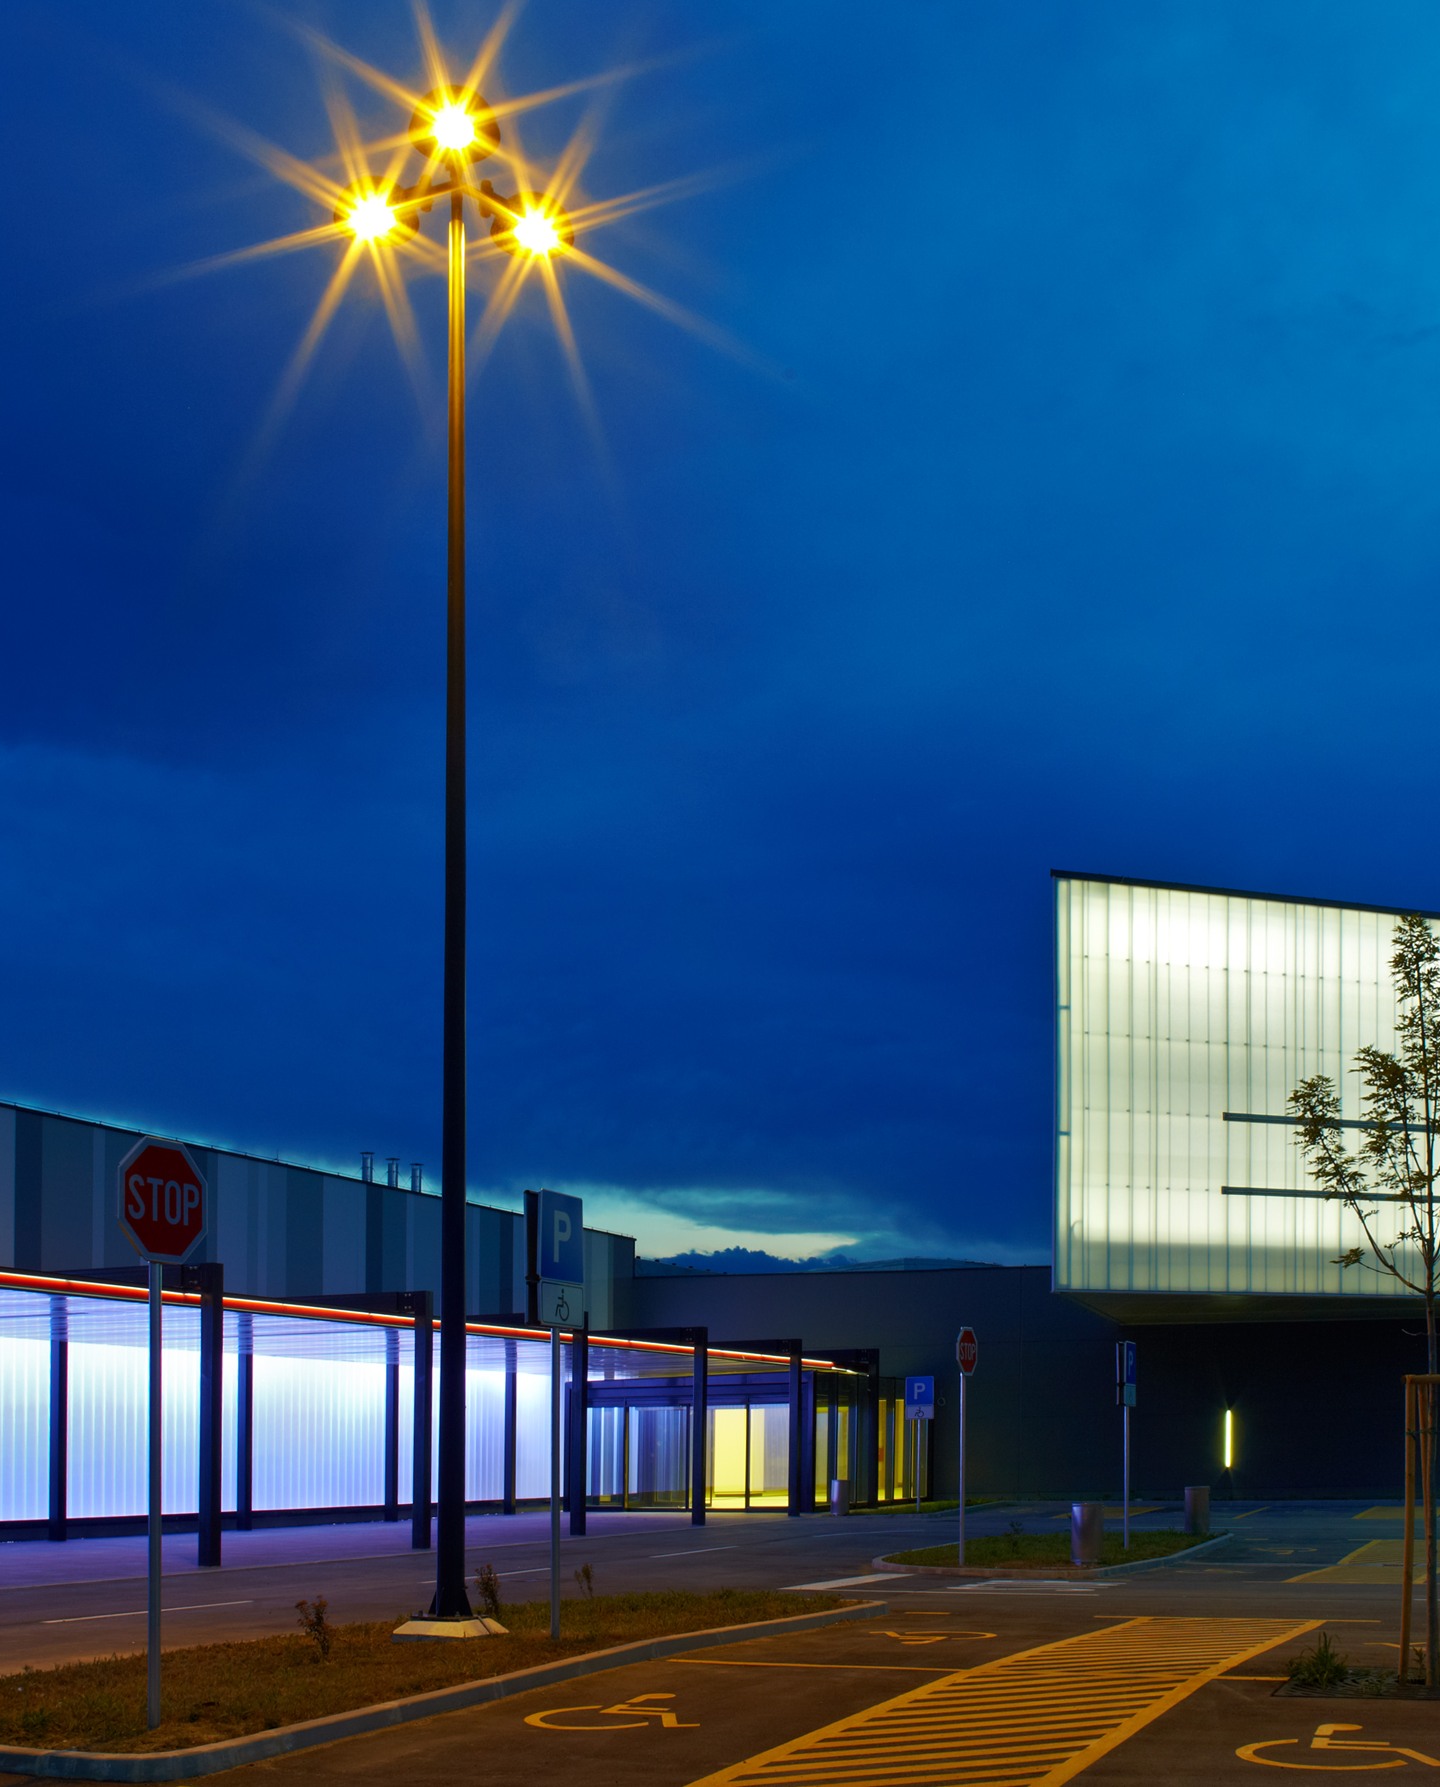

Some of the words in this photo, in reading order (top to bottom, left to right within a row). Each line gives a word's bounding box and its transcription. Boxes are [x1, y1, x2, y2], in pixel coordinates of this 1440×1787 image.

[128, 1174, 200, 1226] STOP
[553, 1209, 572, 1263] P
[960, 1342, 976, 1360] STOP
[913, 1382, 926, 1400] P
